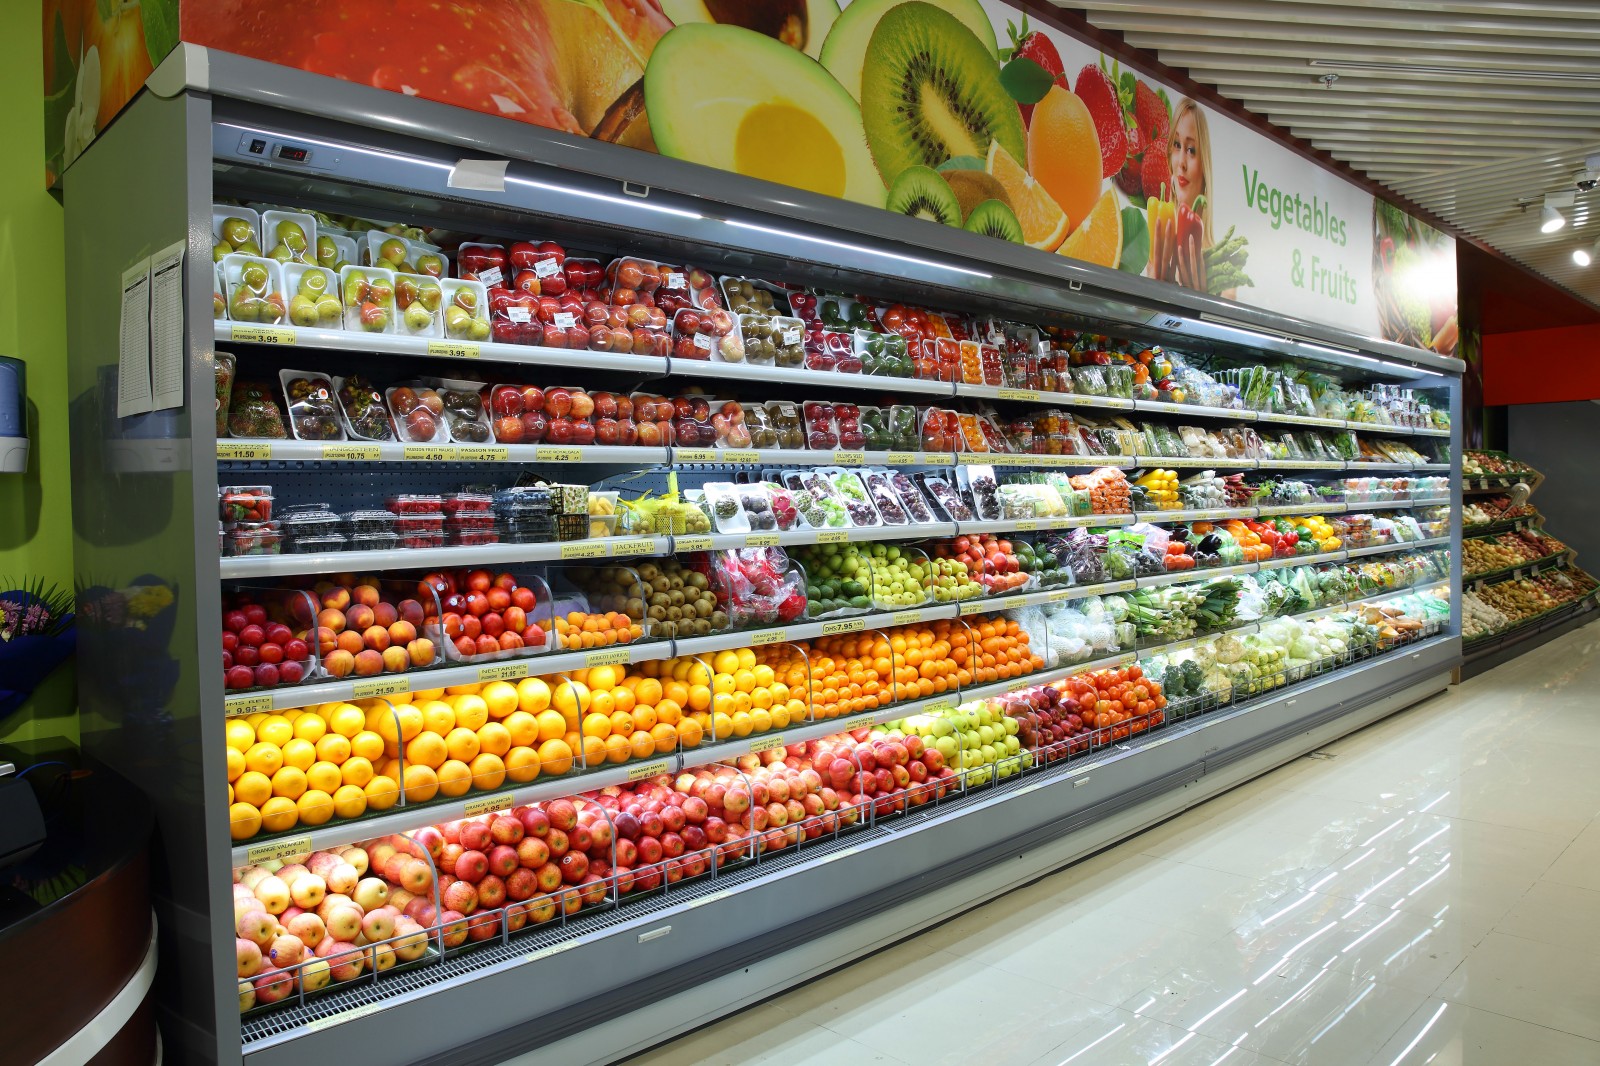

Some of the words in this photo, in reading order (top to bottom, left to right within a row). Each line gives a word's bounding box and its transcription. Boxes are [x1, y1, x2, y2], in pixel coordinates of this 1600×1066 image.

[1242, 164, 1347, 247] Vegetables
[1291, 248, 1305, 288] &
[1311, 255, 1358, 305] Fruits
[258, 335, 278, 344] 3.95
[233, 450, 255, 458] 11.50
[614, 541, 653, 550] JACKFRUIT
[481, 664, 527, 674] NECTARINES
[375, 687, 395, 695] 21.50
[236, 705, 257, 714] 9.95
[483, 804, 501, 813] 5.95
[251, 846, 276, 856] ORANGE
[276, 849, 297, 859] 5.95
